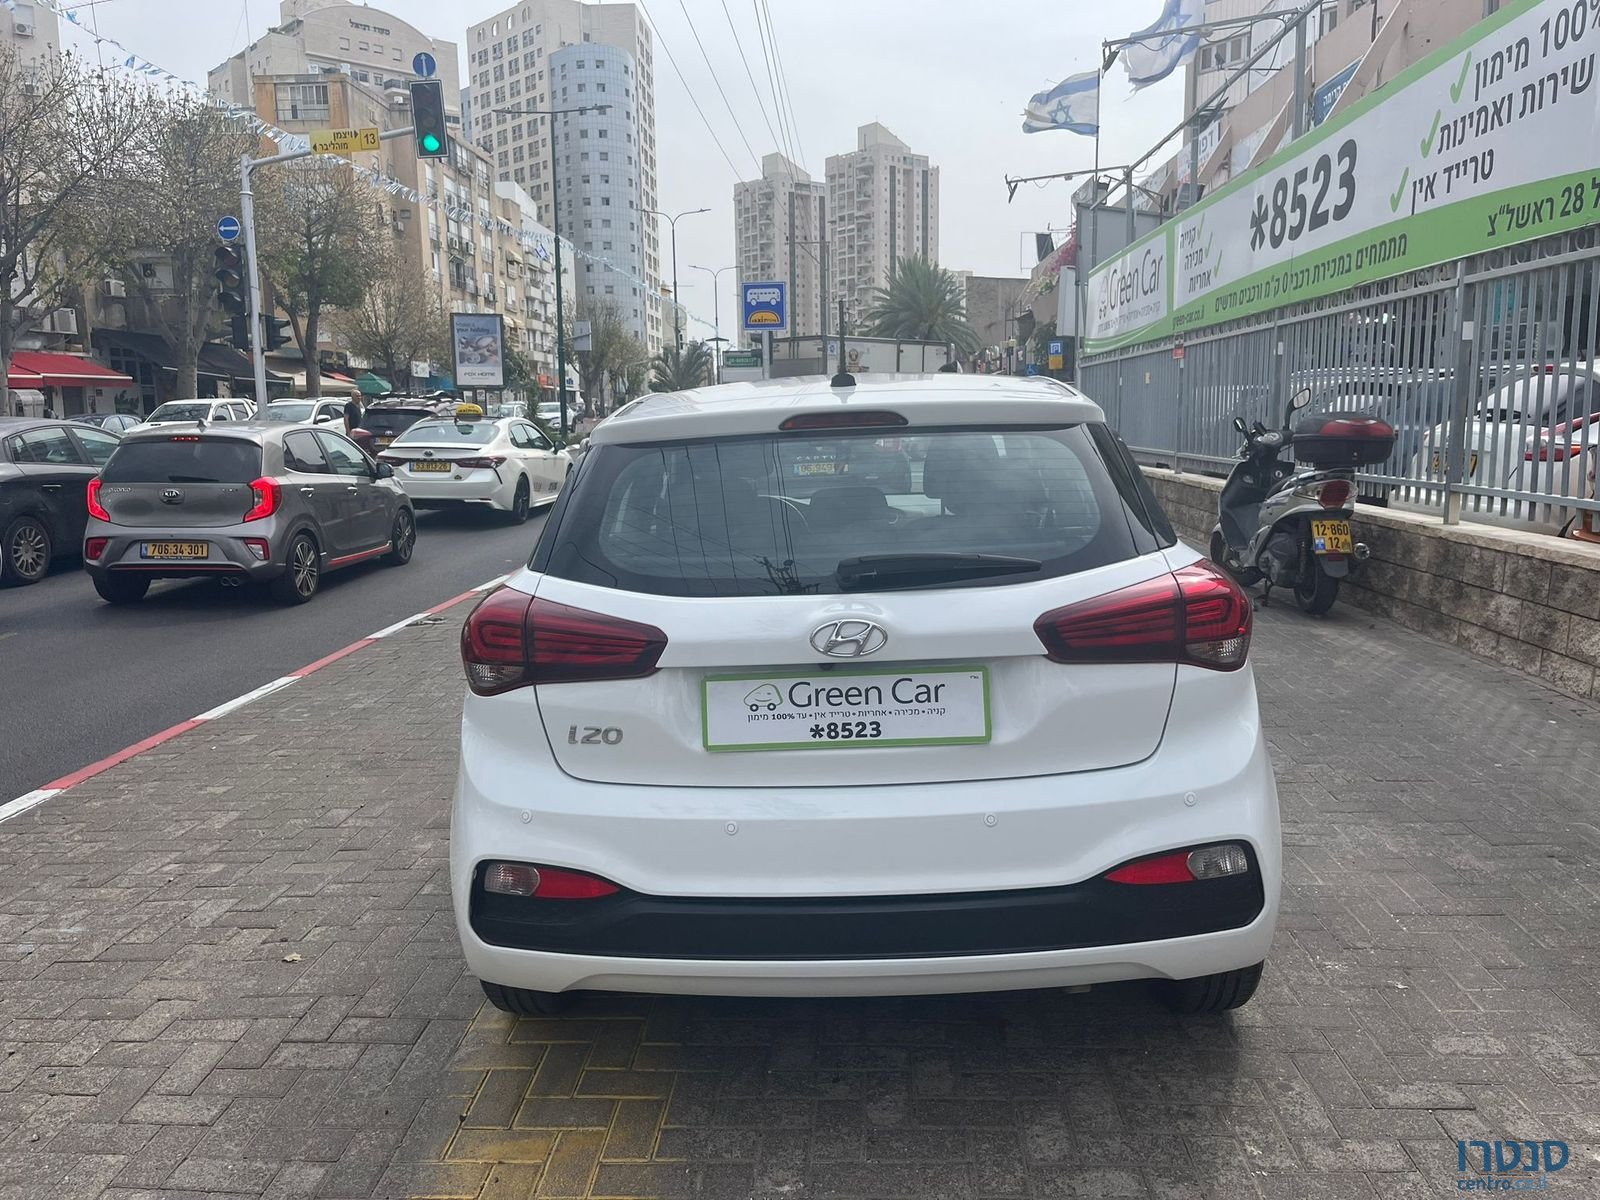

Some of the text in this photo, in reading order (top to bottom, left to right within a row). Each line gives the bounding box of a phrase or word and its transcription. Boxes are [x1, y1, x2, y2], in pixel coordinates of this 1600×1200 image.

[1474, 36, 1530, 102] מימון
[1438, 53, 1595, 154] שירות ואמינות
[332, 130, 353, 141] ויצמן
[364, 133, 376, 145] 13
[1411, 149, 1495, 215] טרייד אין
[1559, 182, 1585, 218] 28
[1355, 233, 1408, 270] מתמחים
[1312, 252, 1352, 284] במכירת
[1109, 249, 1163, 311] Green Car
[1215, 290, 1238, 313] חדשים
[1328, 537, 1340, 549] 12
[788, 677, 945, 708] Green Car
[747, 714, 769, 723] מימון
[814, 711, 827, 720] אין
[858, 709, 887, 717] אחריות
[894, 708, 920, 716] מכירה
[927, 707, 946, 716] קניה
